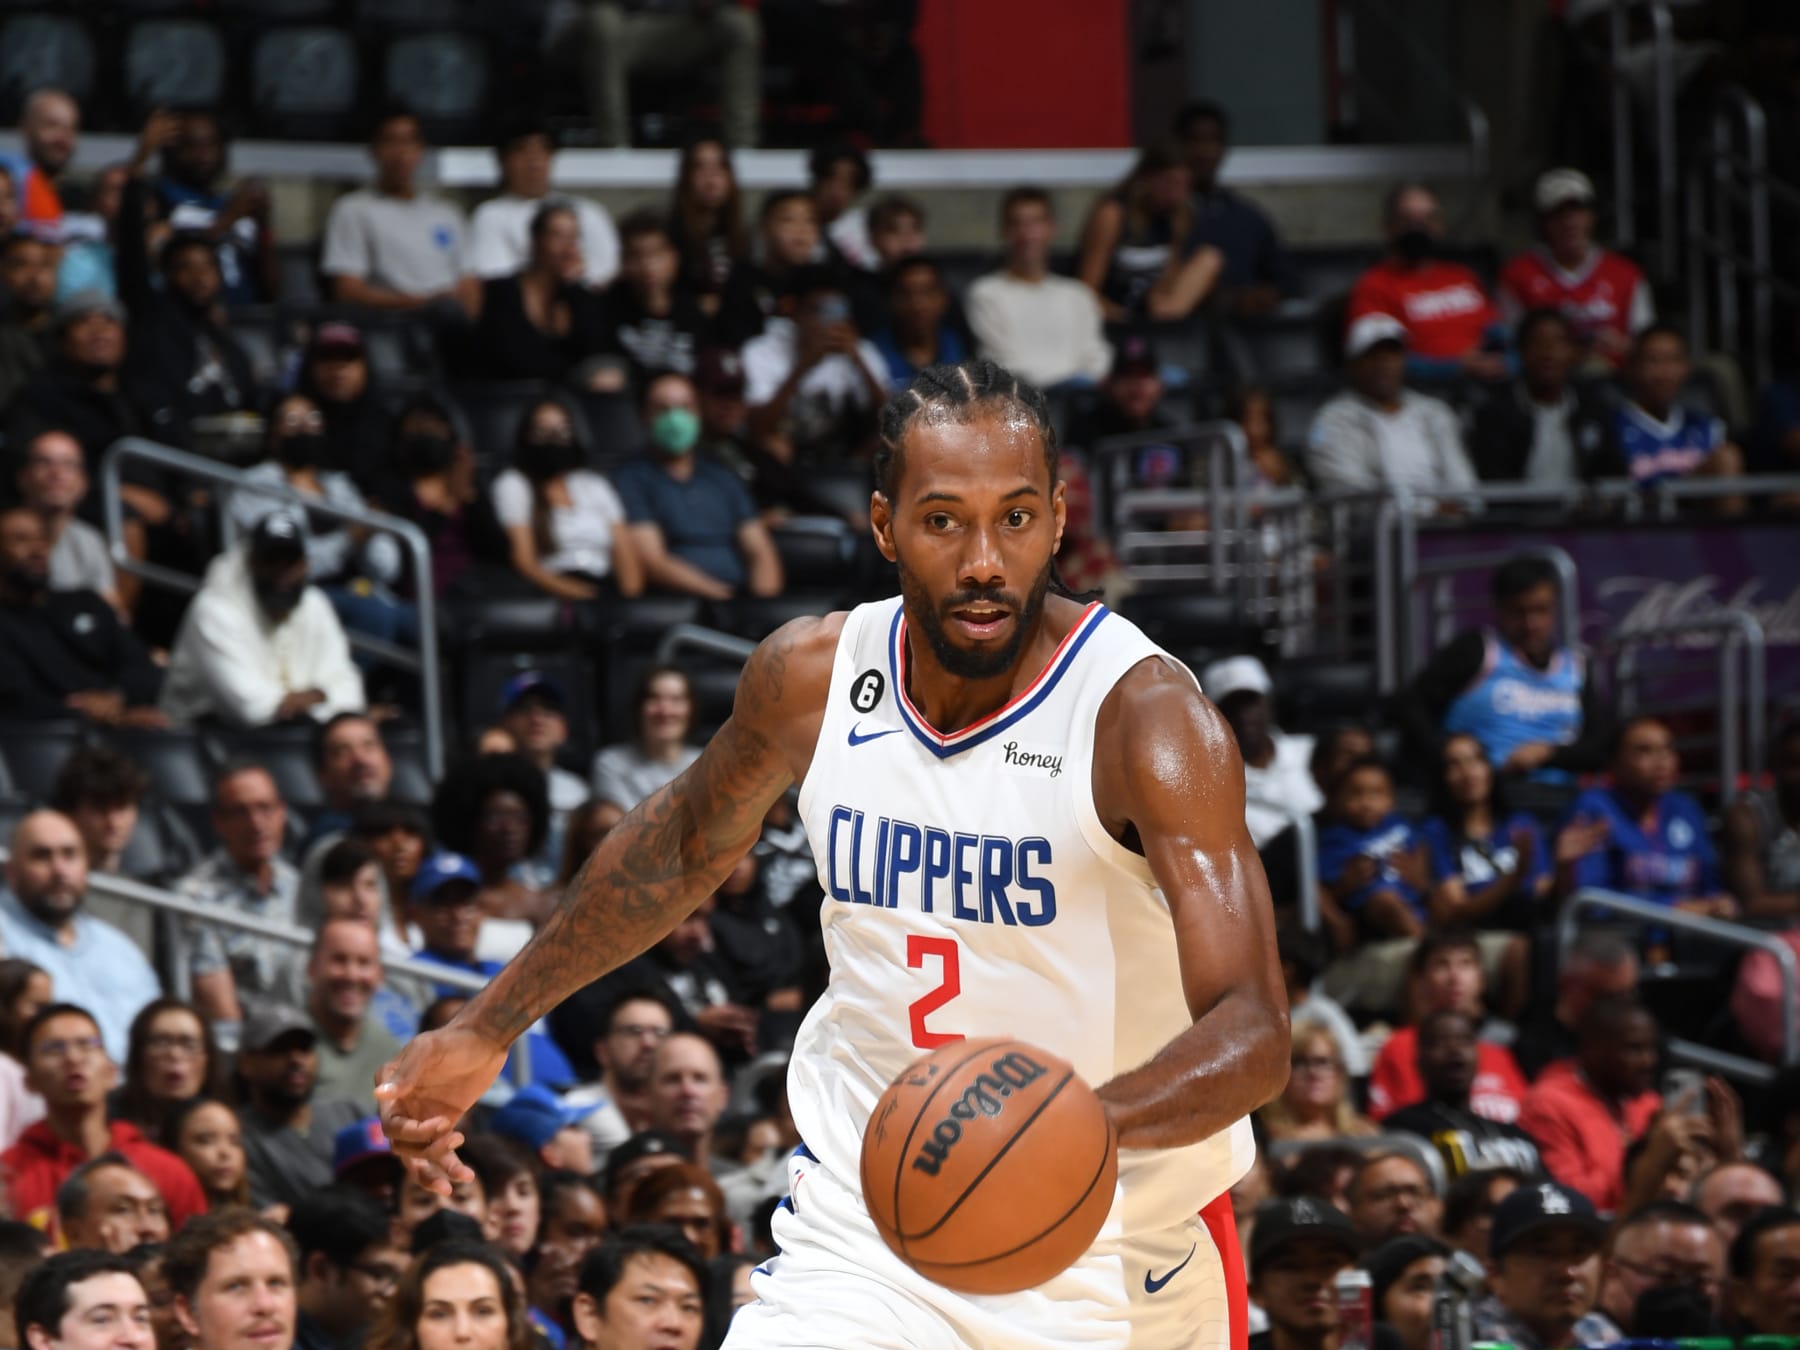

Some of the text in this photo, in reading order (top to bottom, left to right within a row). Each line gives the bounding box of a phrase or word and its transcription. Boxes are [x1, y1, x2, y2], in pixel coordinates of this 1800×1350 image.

[856, 674, 878, 710] 6
[1003, 741, 1063, 778] honey
[827, 804, 1057, 927] CLIPPERS
[906, 934, 966, 1050] 2
[912, 1051, 1048, 1178] Wilson
